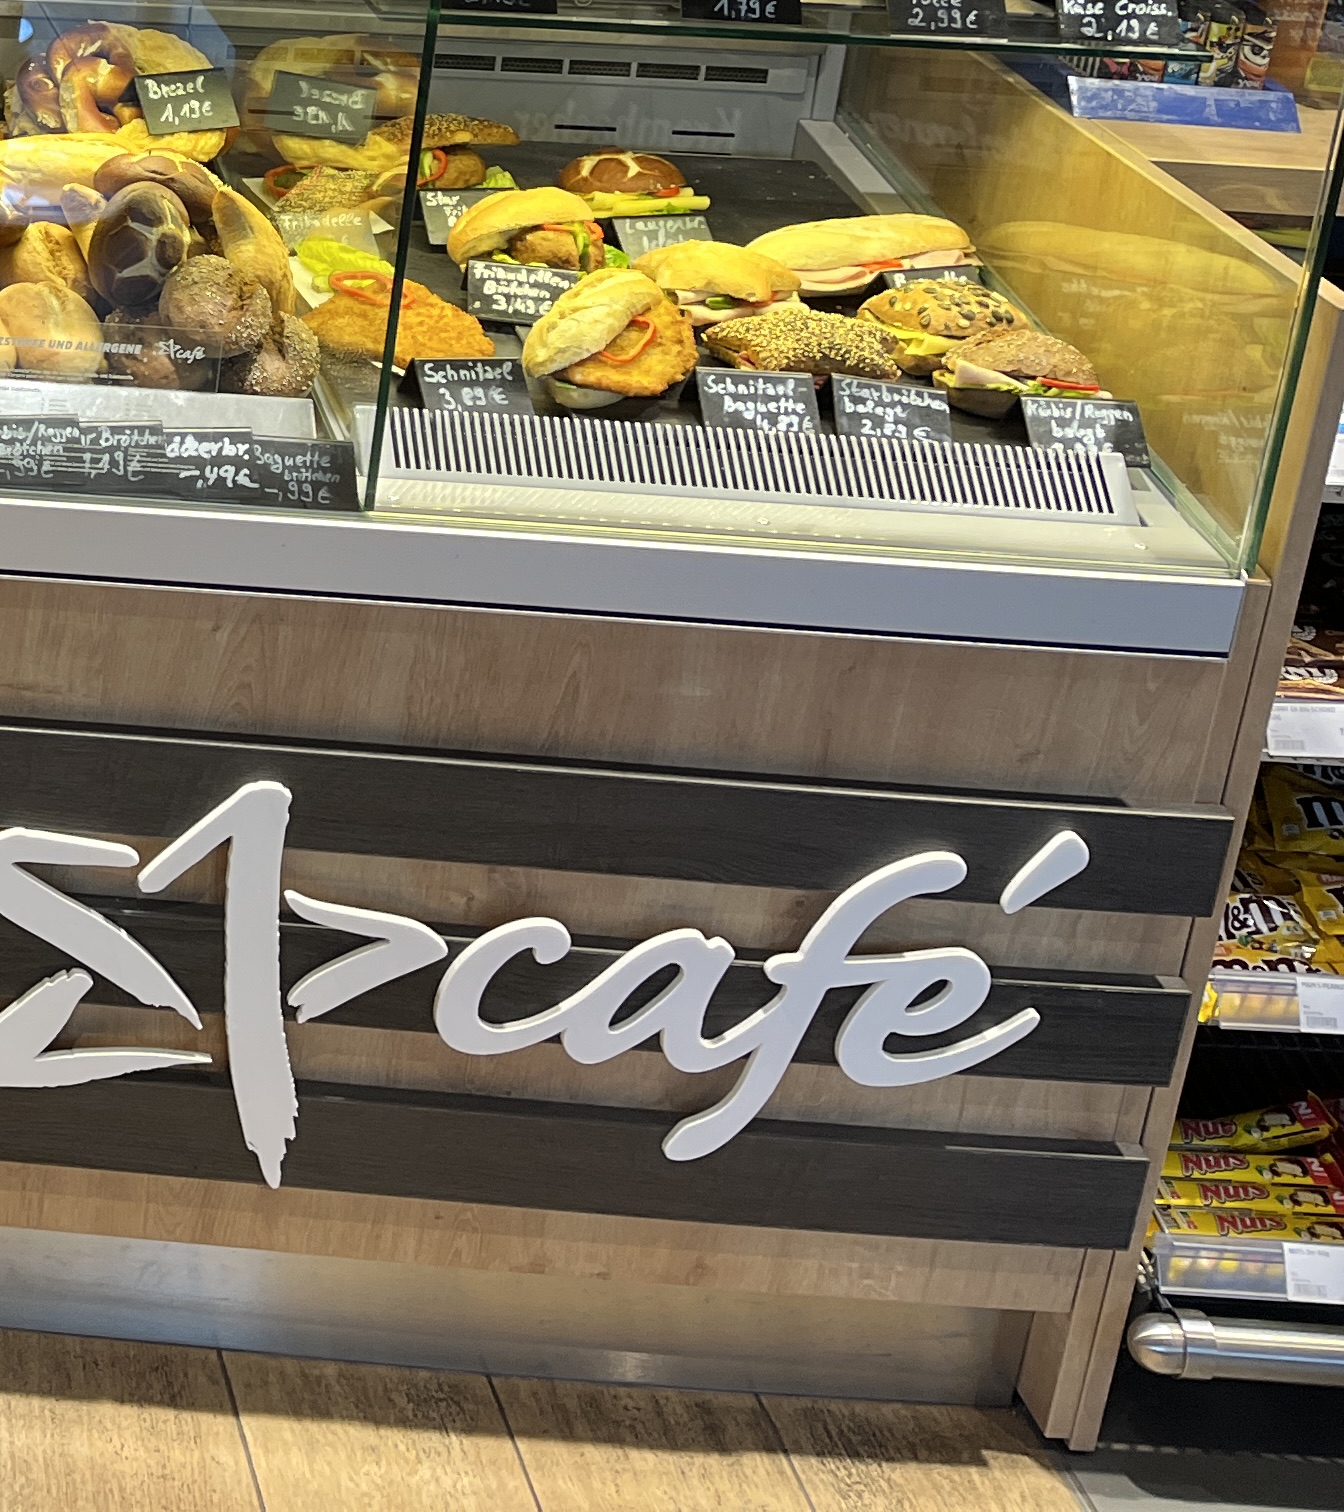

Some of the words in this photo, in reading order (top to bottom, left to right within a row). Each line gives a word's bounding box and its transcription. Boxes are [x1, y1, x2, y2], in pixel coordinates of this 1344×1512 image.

[147, 75, 206, 99] Brezel
[74, 340, 142, 356] ALLERGENE
[175, 344, 207, 363] café
[433, 830, 1091, 1162] café
[1180, 1152, 1249, 1176] Nuts
[1199, 1183, 1270, 1207] Nuts
[1214, 1213, 1287, 1236] Nuts
